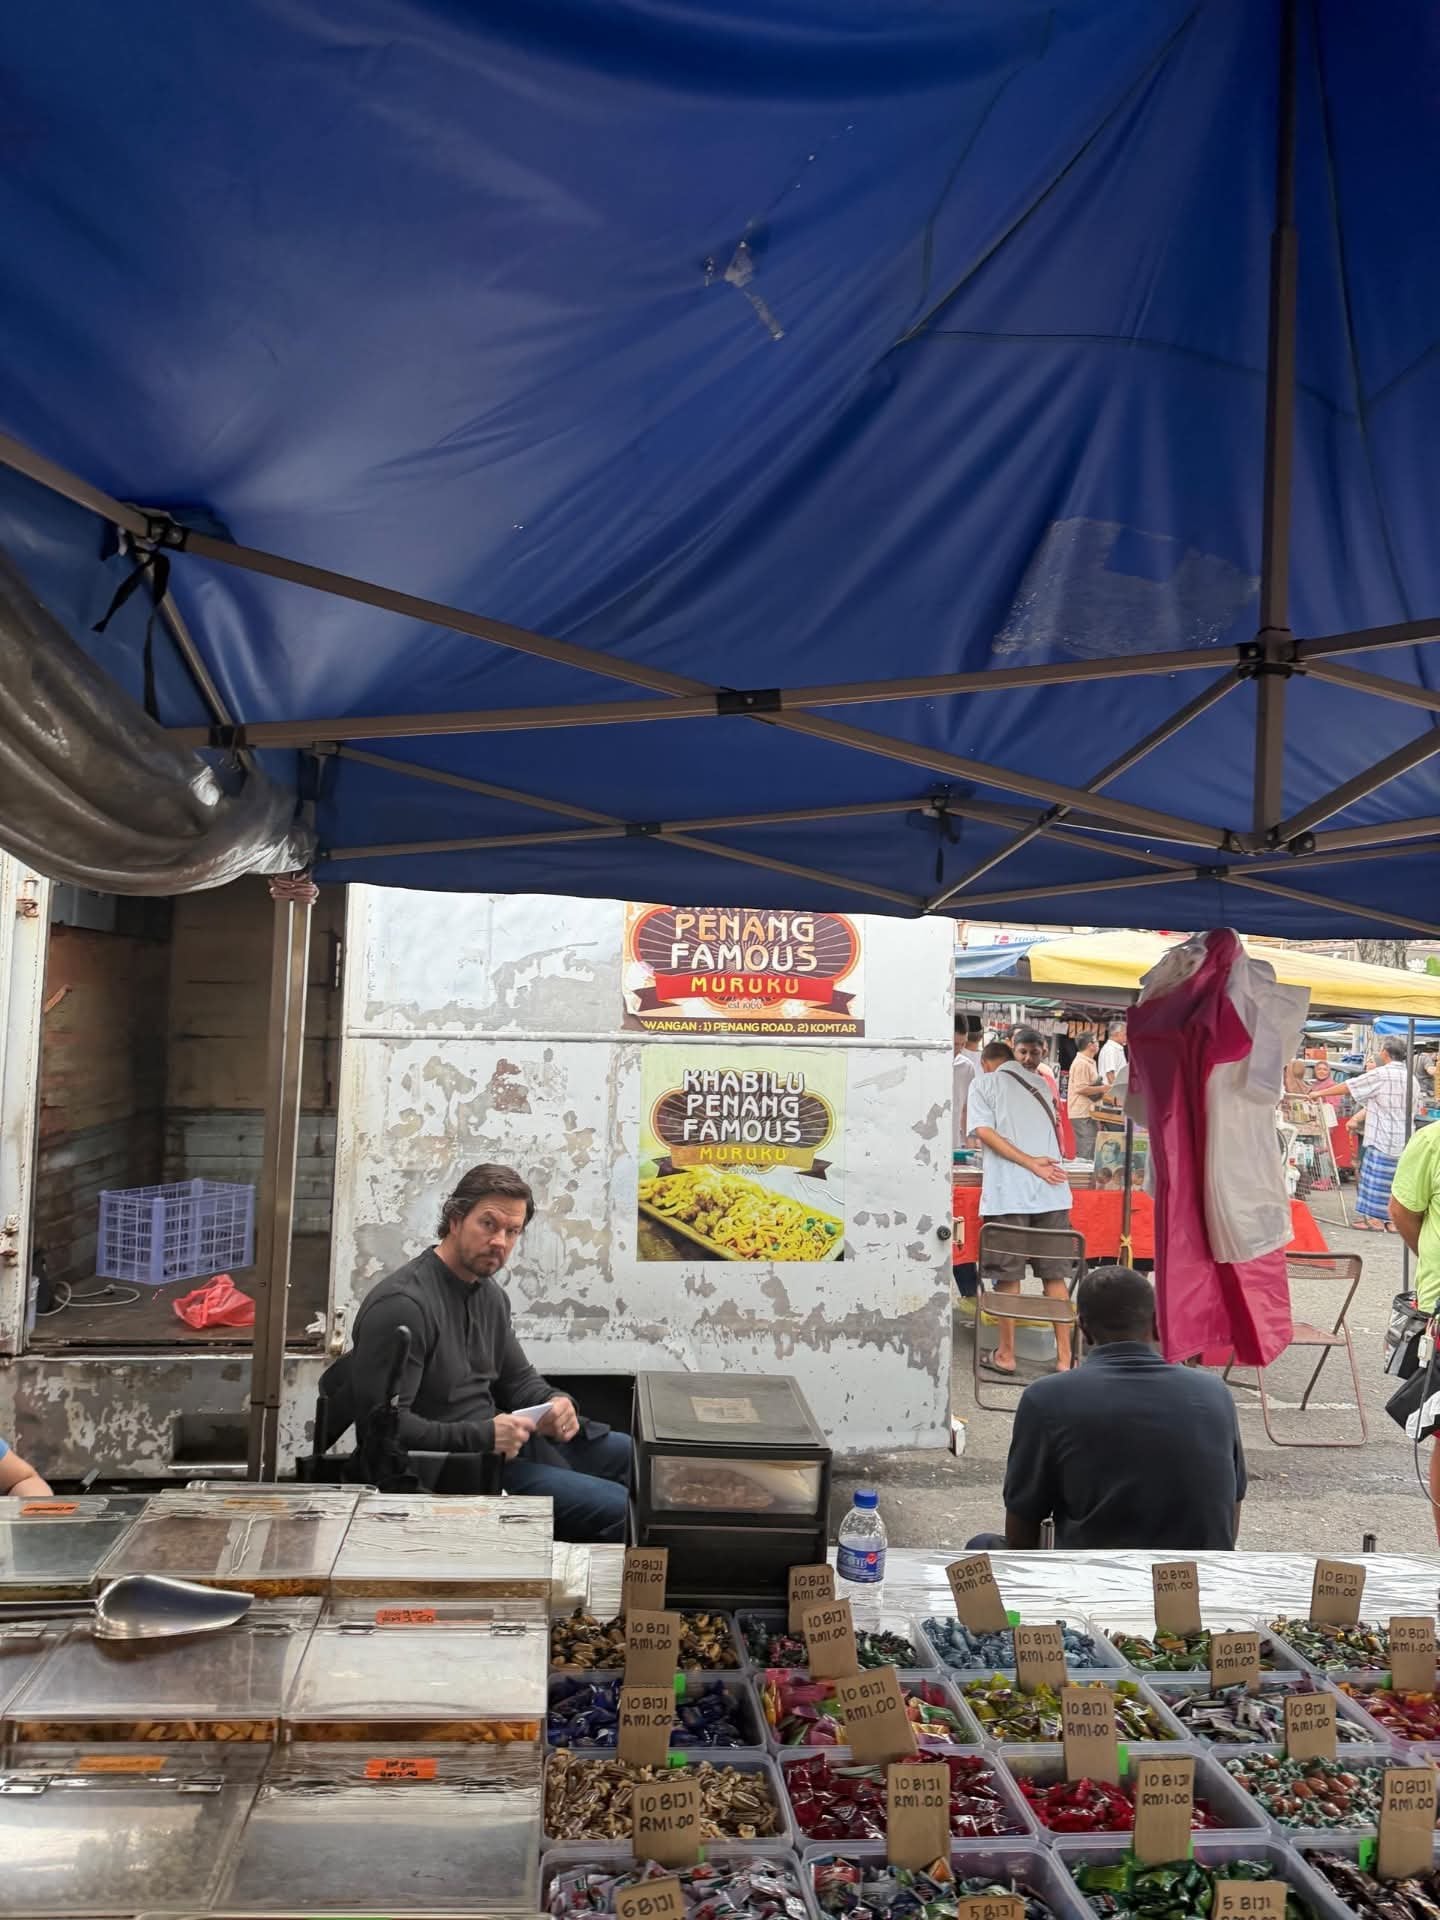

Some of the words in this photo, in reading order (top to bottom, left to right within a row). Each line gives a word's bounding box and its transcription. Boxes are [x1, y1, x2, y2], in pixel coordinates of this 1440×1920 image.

[675, 914, 814, 942] PENANG
[671, 943, 817, 971] FAMOUS
[691, 977, 799, 993] MURUKU
[641, 1019, 696, 1032] WANGAN
[713, 1022, 760, 1033] PENANG
[810, 1023, 857, 1034] KOMTAR
[684, 1070, 804, 1094] KHABILU
[687, 1094, 799, 1118] PENANG
[683, 1119, 801, 1142] FAMOUS
[700, 1148, 786, 1160] MURUKU
